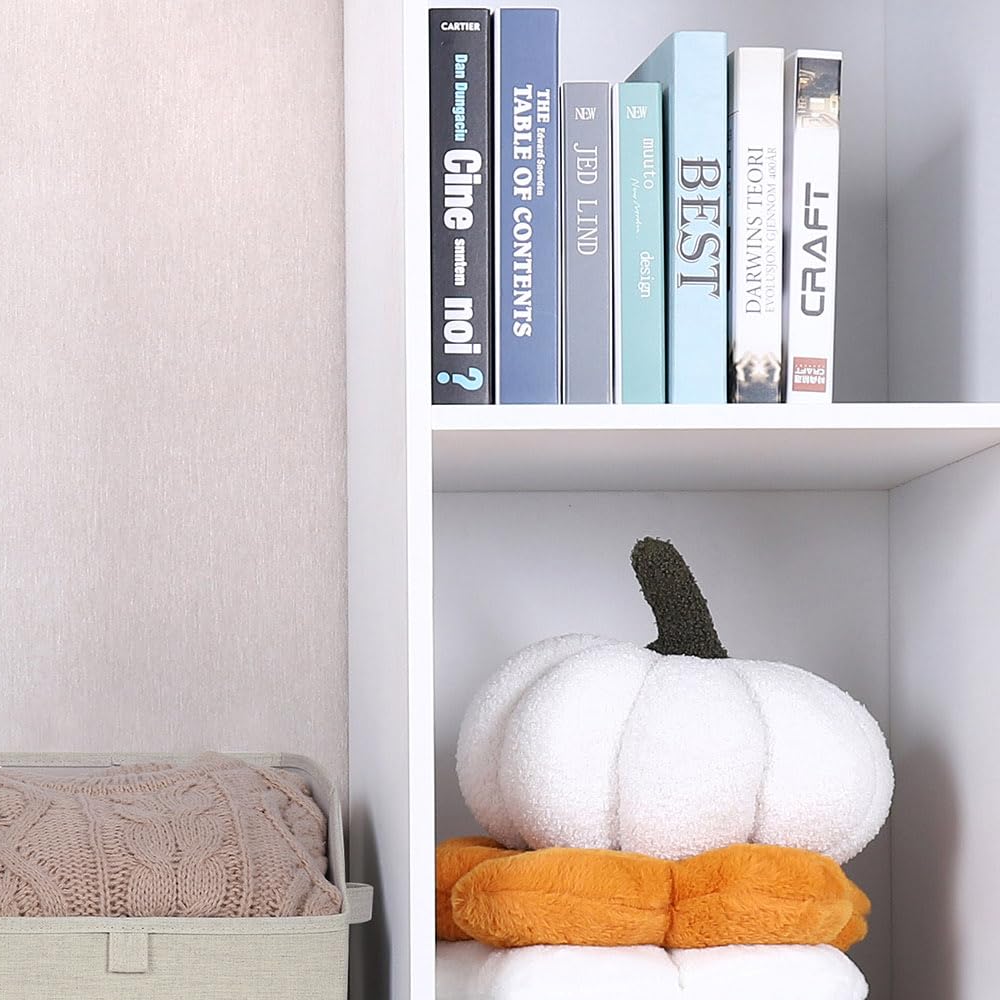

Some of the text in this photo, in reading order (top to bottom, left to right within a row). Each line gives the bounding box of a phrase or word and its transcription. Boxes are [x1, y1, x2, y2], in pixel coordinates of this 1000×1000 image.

[440, 22, 481, 31] CARTIER
[452, 54, 468, 142] Dan Dungaciu
[575, 106, 597, 121] NEW
[626, 105, 648, 120] NEW
[535, 88, 551, 197] THE Edward Snowden
[642, 137, 656, 191] muuto
[442, 148, 483, 231] Cine
[512, 83, 534, 337] TABLE OF CONTENTS
[573, 142, 600, 256] JED LIND
[676, 155, 722, 299] BEST
[745, 147, 764, 315] DARWINS TEORI
[637, 250, 656, 299] design
[800, 181, 830, 317] CRAFT
[443, 297, 482, 355] noi
